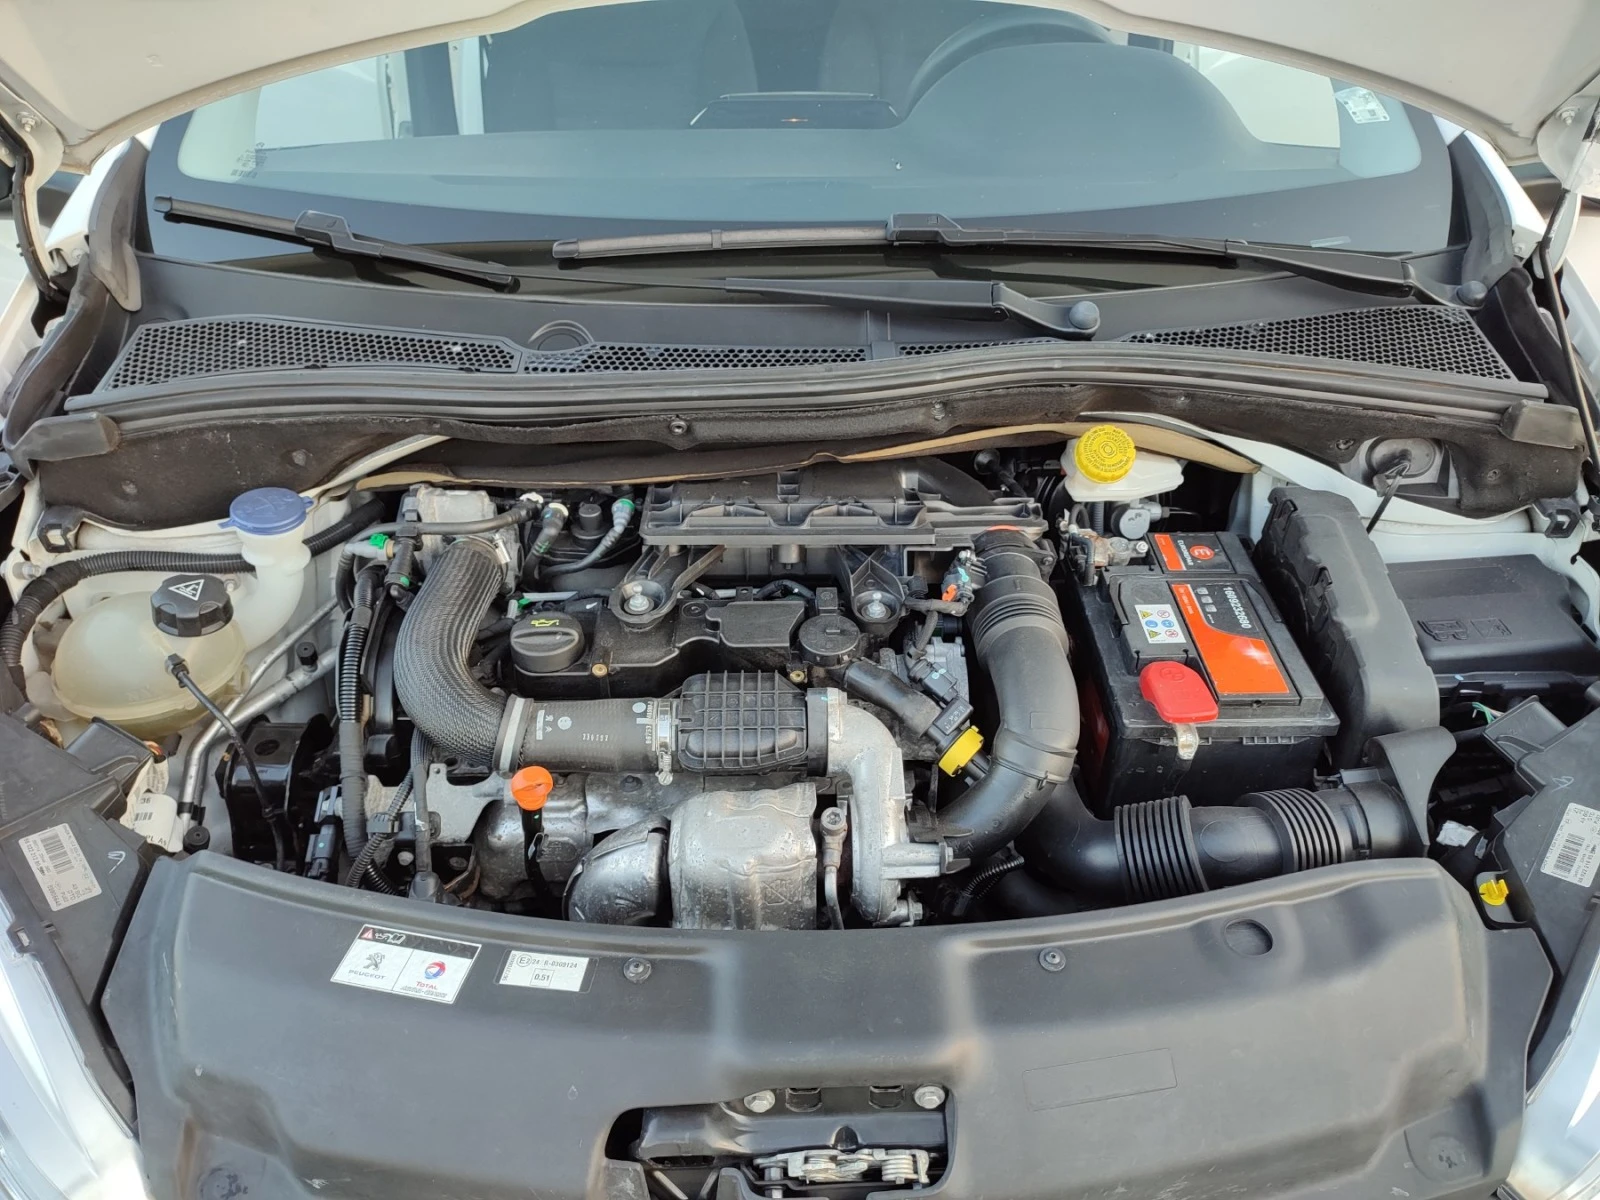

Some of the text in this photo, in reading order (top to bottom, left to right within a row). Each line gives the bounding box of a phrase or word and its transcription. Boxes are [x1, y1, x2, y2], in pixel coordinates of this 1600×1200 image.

[1177, 540, 1194, 566] EUROREPAR
[1223, 586, 1252, 629] 1609232680
[348, 969, 387, 980] PEUGEOT
[534, 973, 551, 981] 0.51
[416, 981, 438, 990] TOTAL
